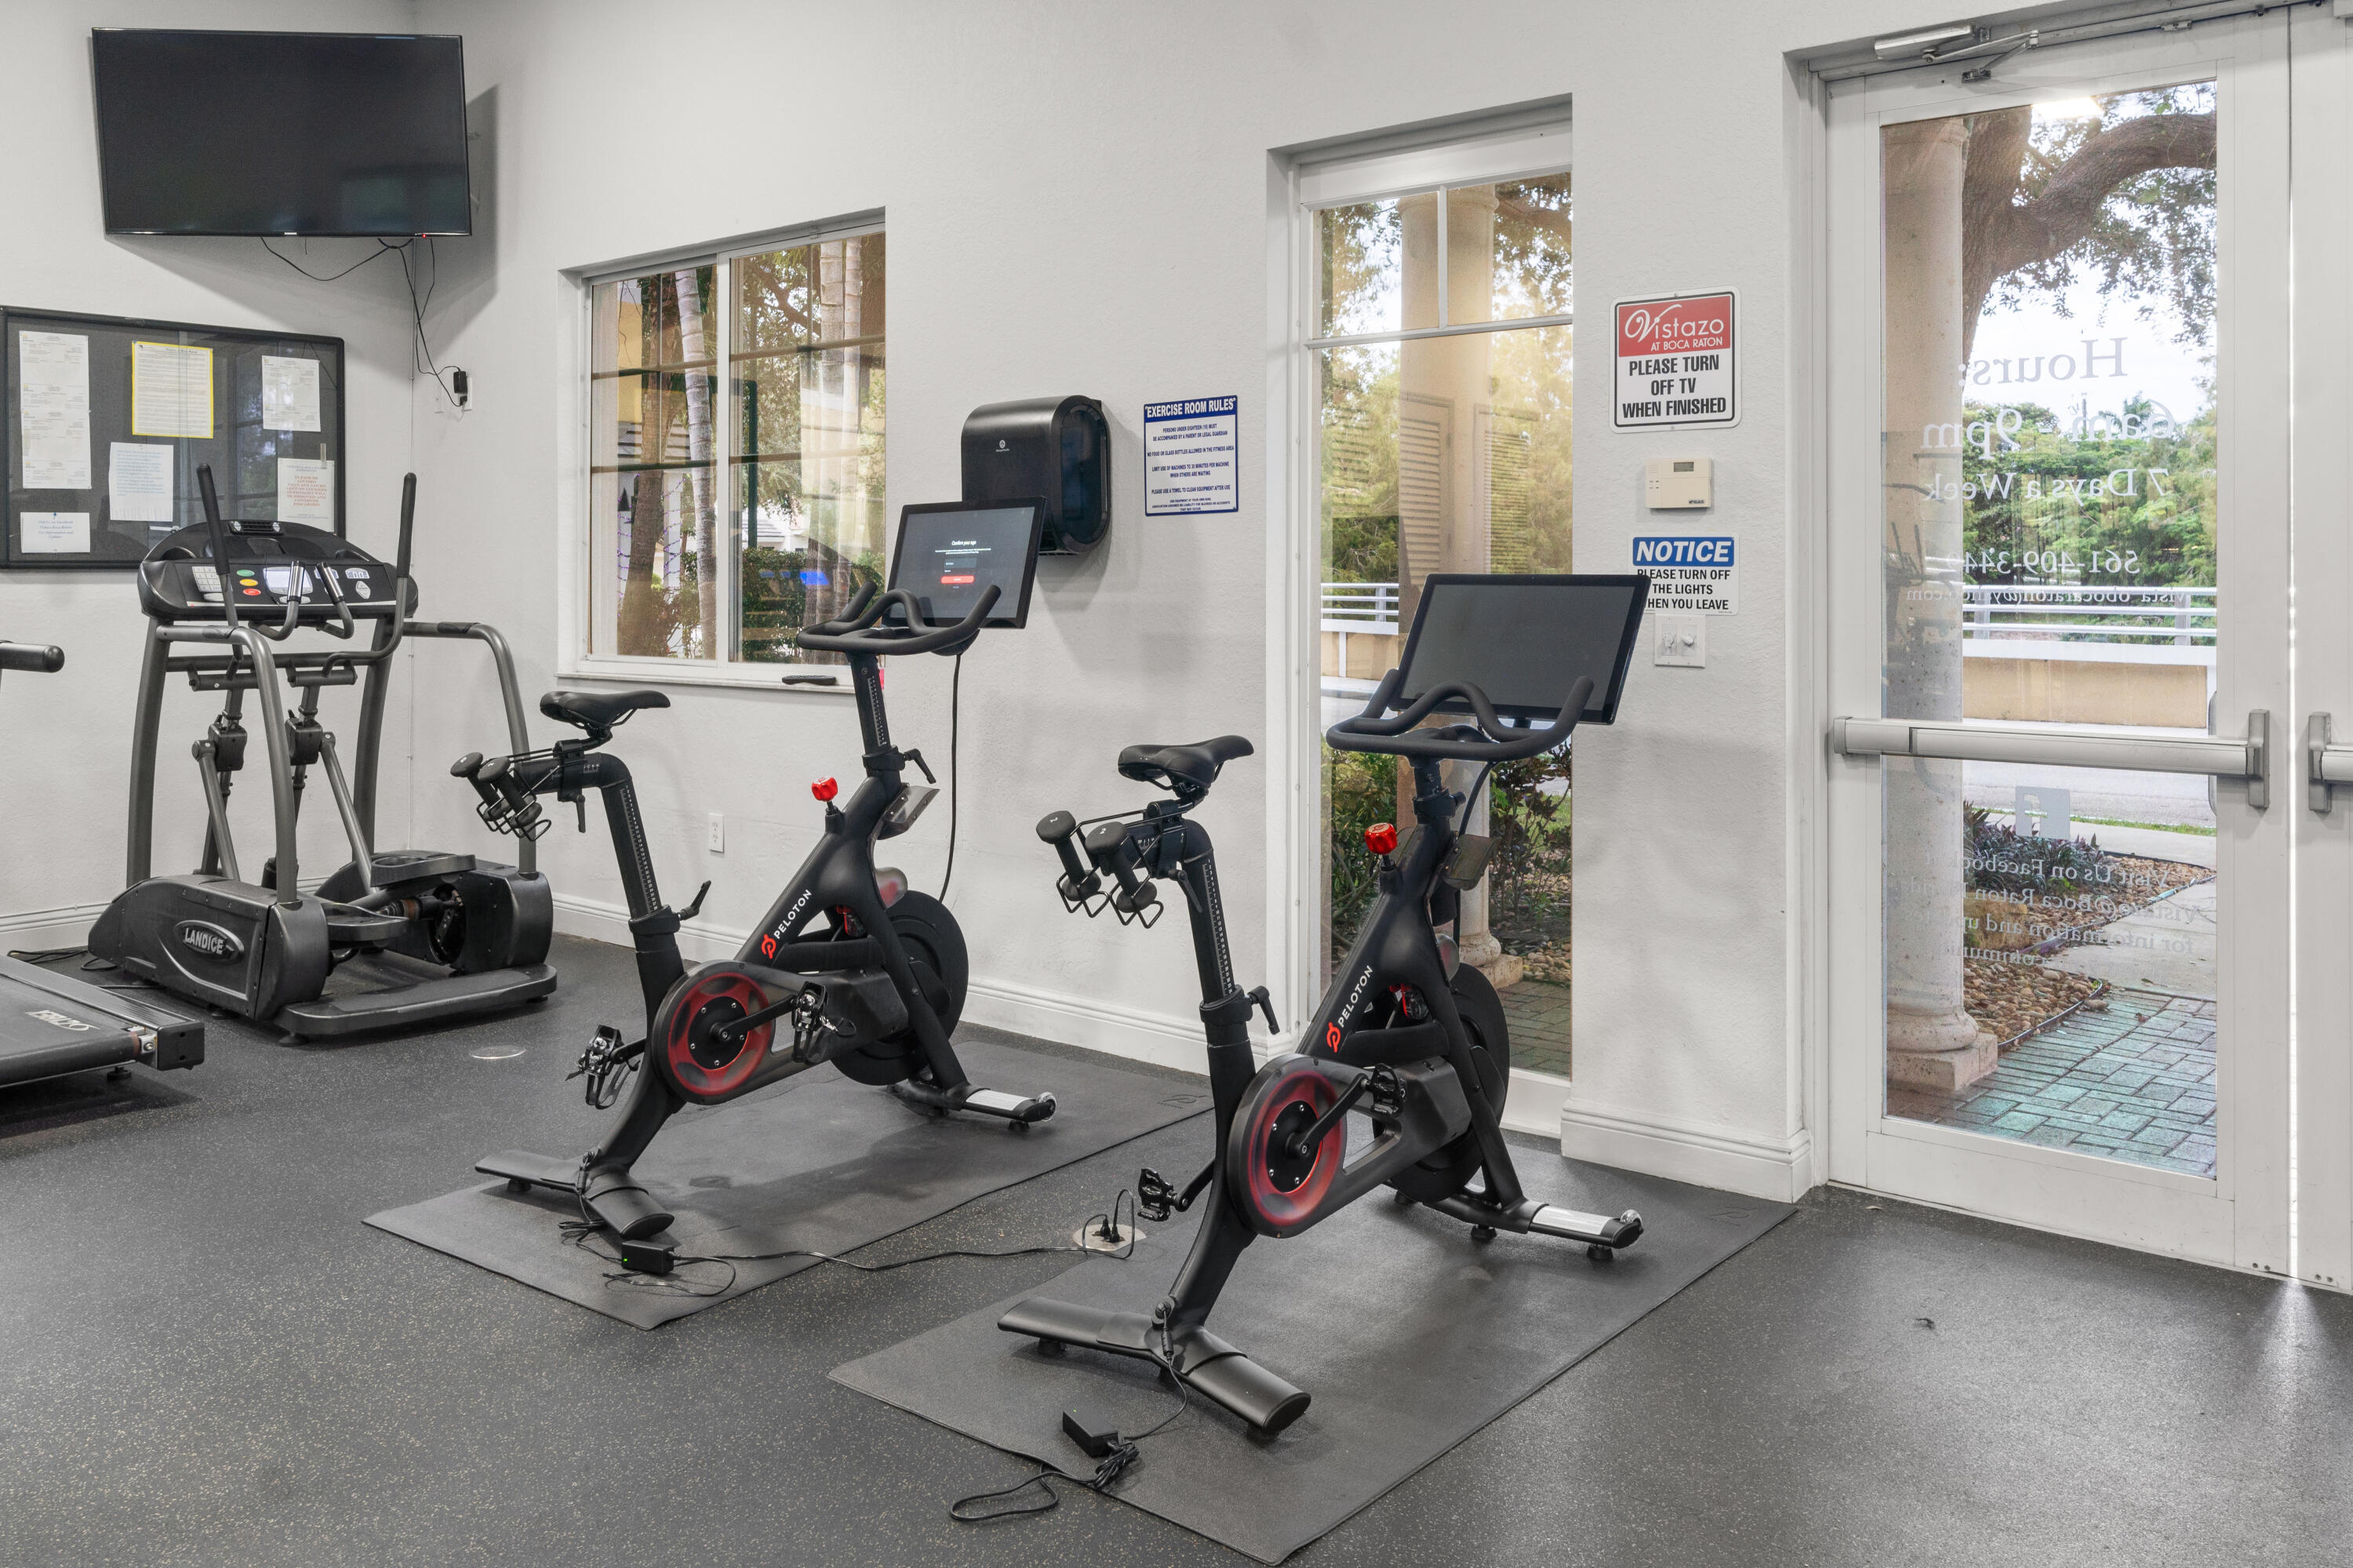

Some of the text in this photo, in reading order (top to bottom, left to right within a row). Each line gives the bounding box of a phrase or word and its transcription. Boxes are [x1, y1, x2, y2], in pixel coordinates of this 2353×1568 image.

[1625, 304, 1724, 343] Vistazo
[1651, 337, 1722, 351] AT BOCA RATON
[1629, 355, 1719, 376] PLEASE TURN
[1651, 378, 1696, 395] OFF TV
[1185, 403, 1206, 414] ROOM
[1623, 397, 1726, 418] WHEN FINISHED
[1637, 541, 1731, 562] NOTICE
[1679, 570, 1706, 579] TURN
[1710, 570, 1730, 580] OFF
[1653, 584, 1713, 594] THE LIGHTS
[1646, 598, 1729, 610] HEN YOU LEAVE
[773, 889, 813, 940] PELOTON
[184, 927, 224, 955] LANDICE
[1337, 965, 1373, 1028] PELOTON
